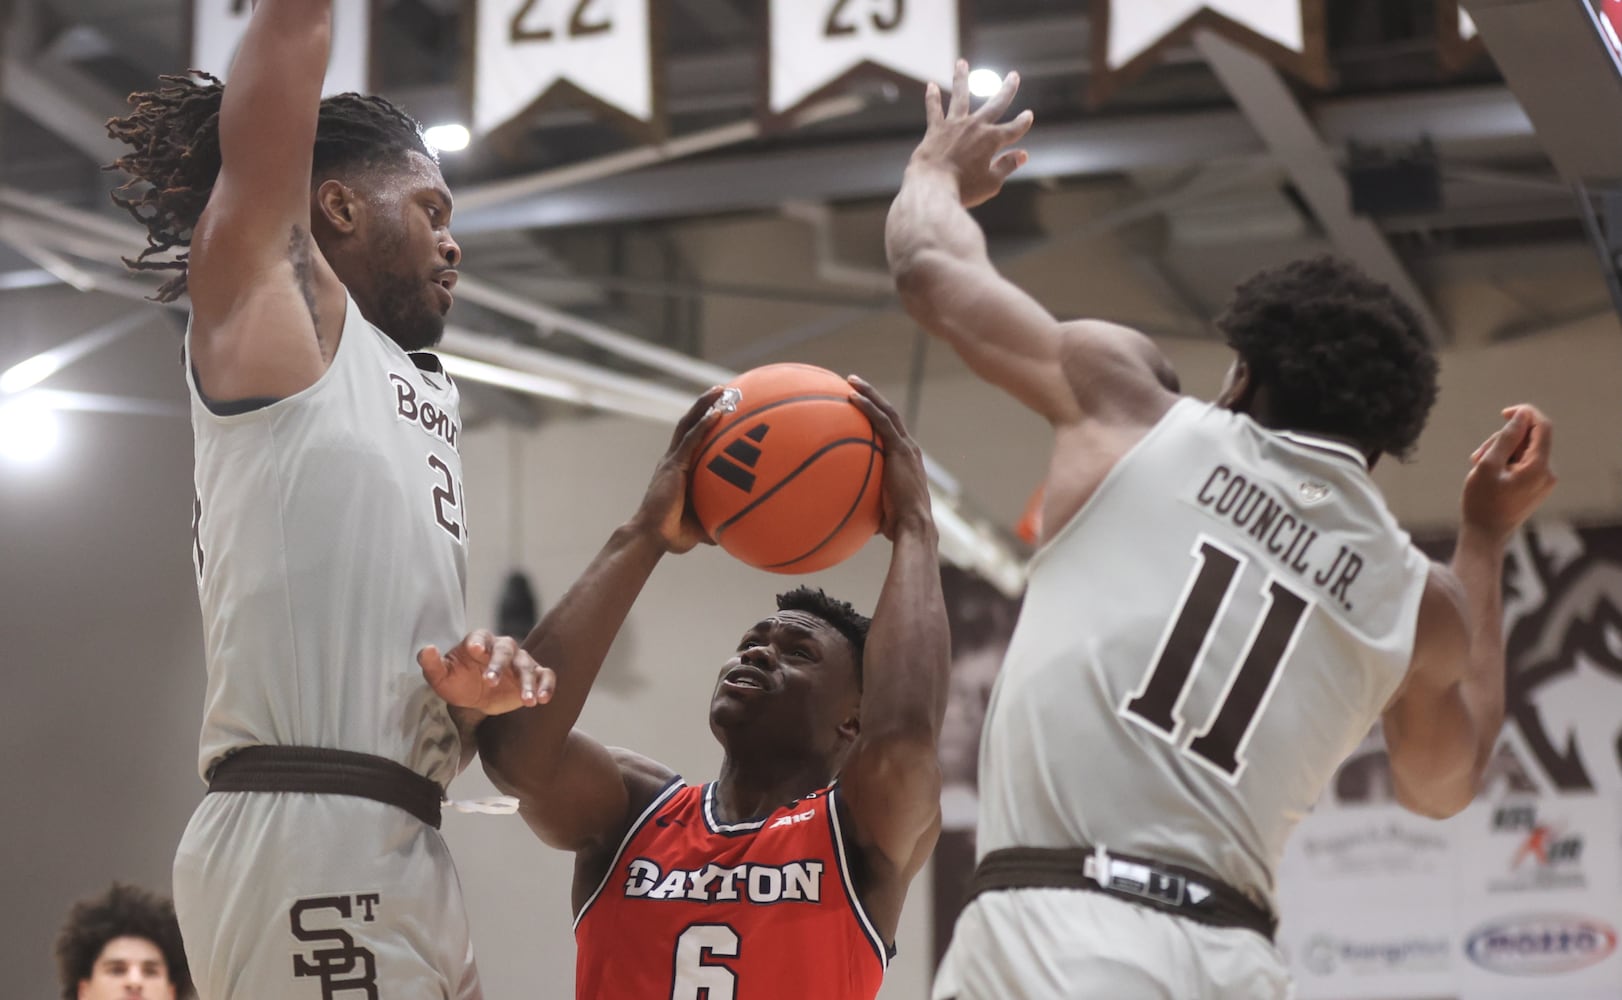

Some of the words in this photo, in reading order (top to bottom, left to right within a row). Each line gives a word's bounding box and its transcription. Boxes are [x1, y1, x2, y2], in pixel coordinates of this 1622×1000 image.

[1197, 465, 1318, 575] COUNCIL
[1313, 545, 1363, 611] JR.
[1119, 534, 1315, 784] 11
[624, 857, 824, 904] DAYTON
[671, 921, 742, 1000] 6
